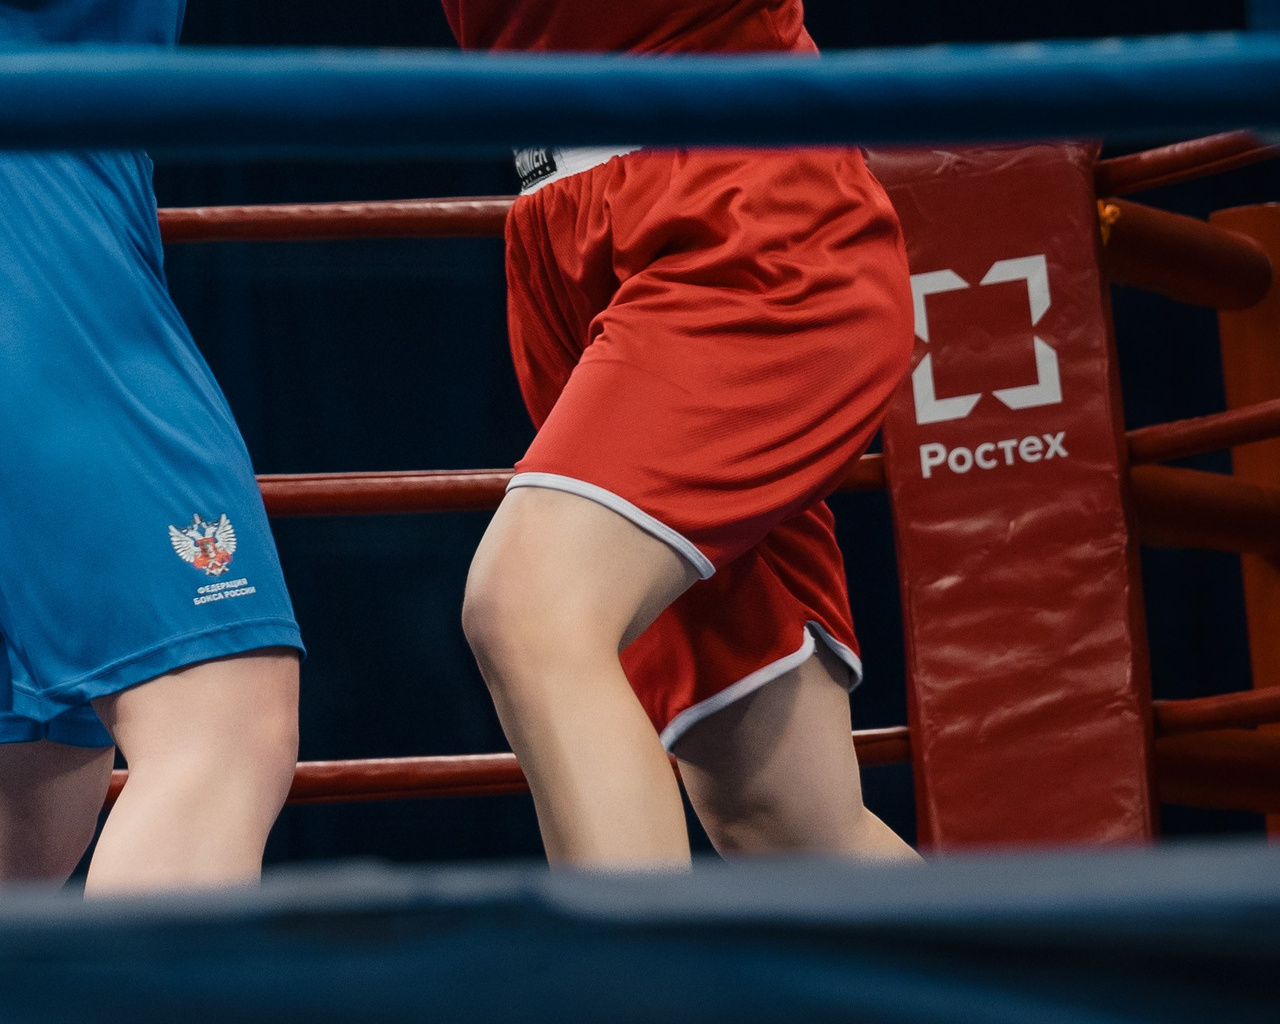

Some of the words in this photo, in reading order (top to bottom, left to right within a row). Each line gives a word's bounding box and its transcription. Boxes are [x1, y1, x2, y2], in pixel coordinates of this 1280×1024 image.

[919, 431, 1069, 479] Ростех
[197, 578, 248, 593] ФЕДЕРАЦИЯ
[193, 592, 224, 605] БОКСА
[224, 586, 256, 598] РОССИИ
